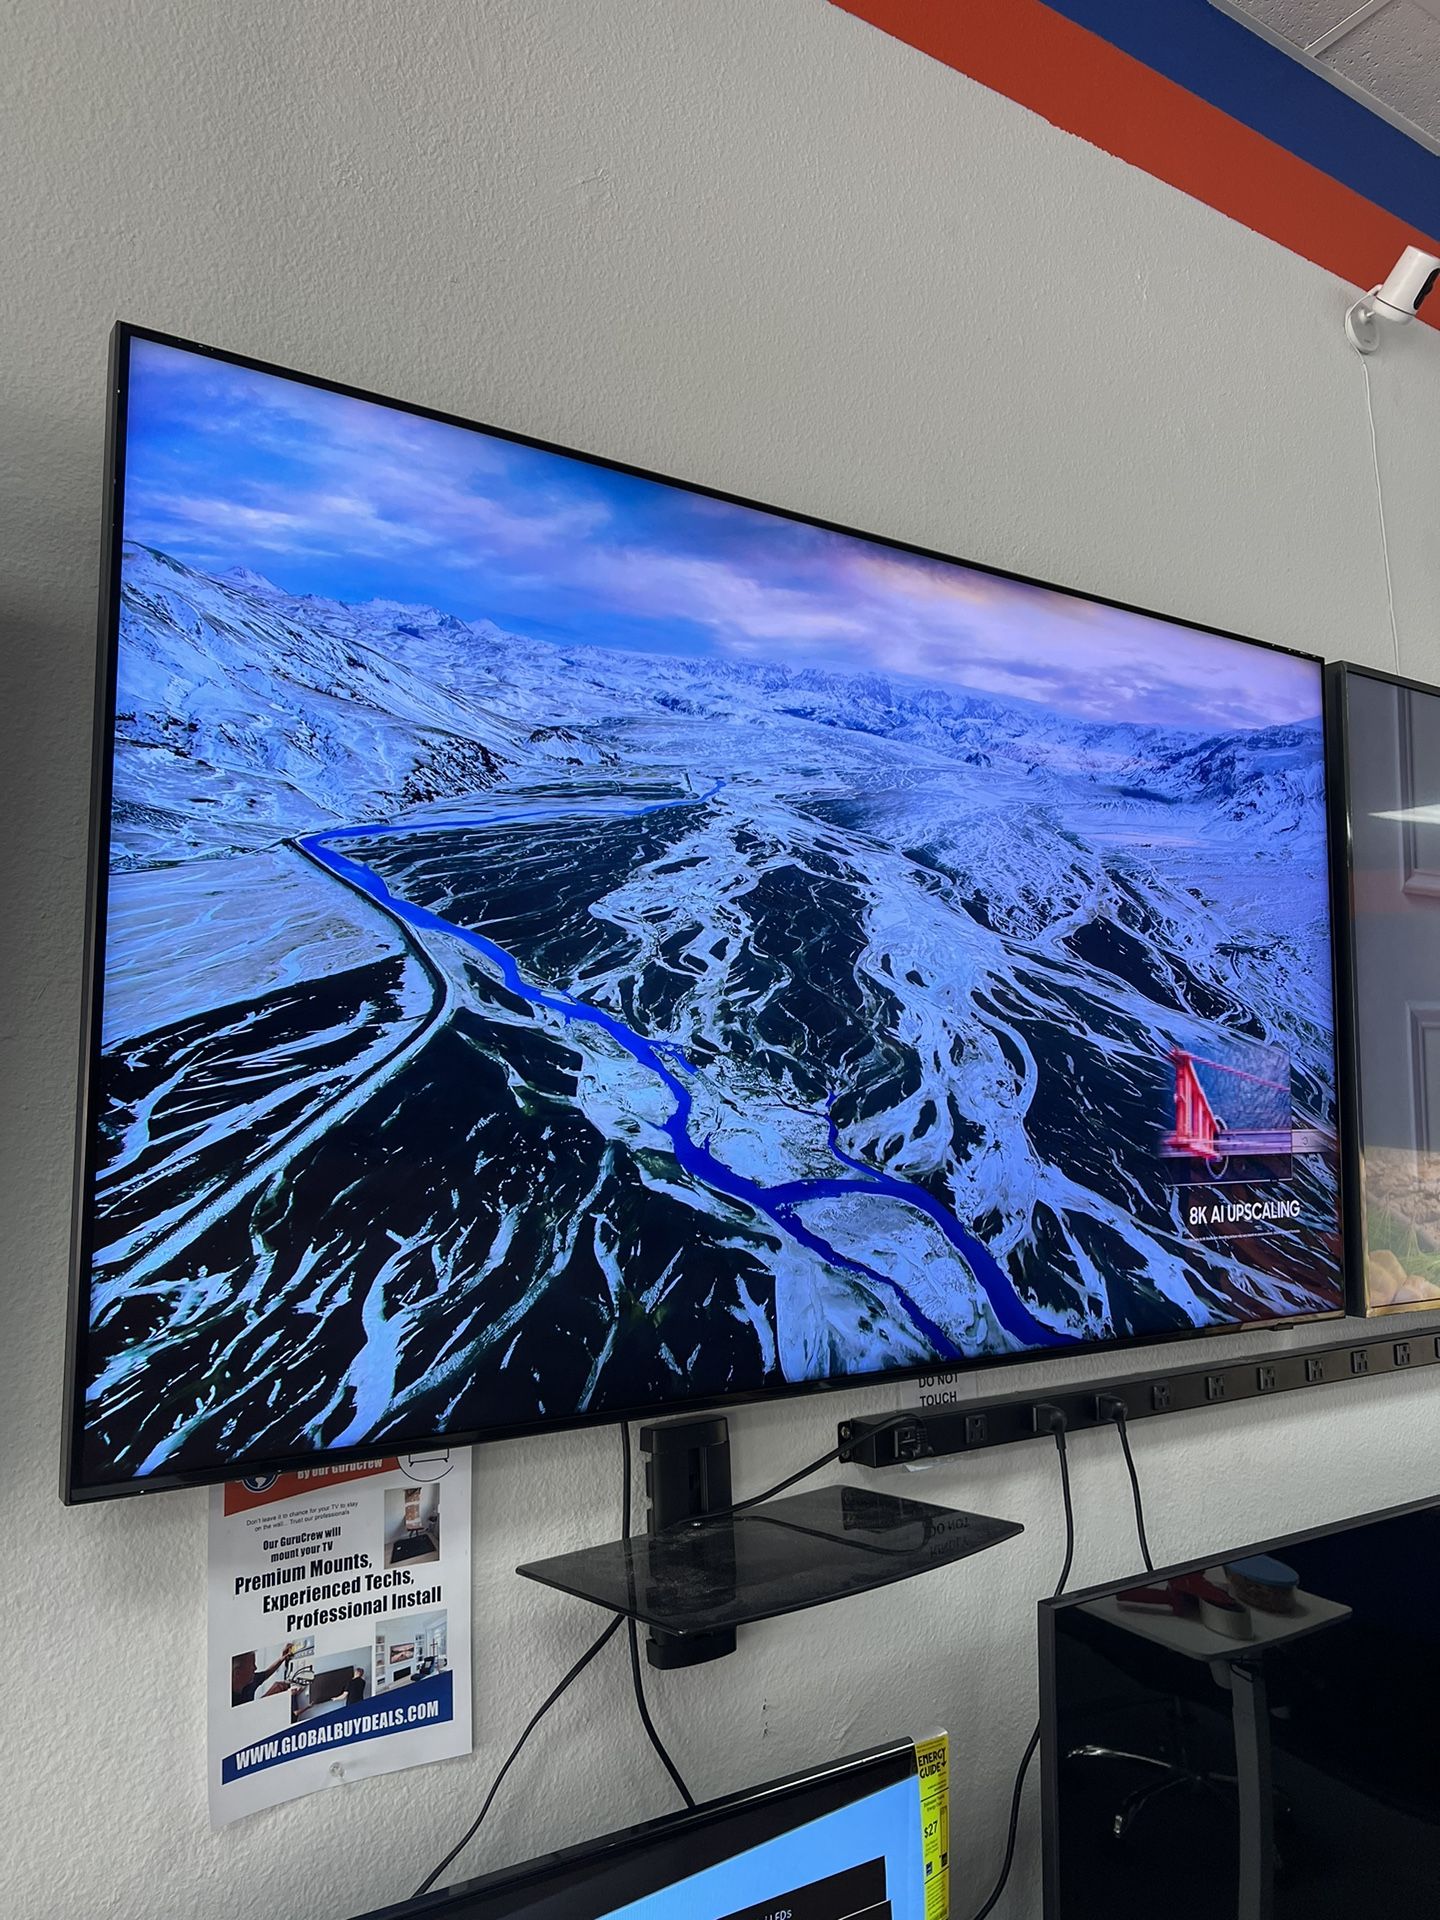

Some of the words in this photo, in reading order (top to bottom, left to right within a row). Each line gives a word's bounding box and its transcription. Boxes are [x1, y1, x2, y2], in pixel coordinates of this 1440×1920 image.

[1189, 1206, 1207, 1225] 8K
[1210, 1205, 1224, 1223] AI
[1227, 1200, 1300, 1222] UPSCALING
[918, 1376, 934, 1388] DO
[938, 1373, 958, 1385] NOT
[920, 1391, 957, 1407] TOUCH
[312, 1466, 329, 1477] our
[262, 1515, 277, 1523] leave
[289, 1510, 308, 1518] chance
[318, 1505, 330, 1513] your
[290, 1517, 303, 1525] Trust
[314, 1509, 350, 1521] professionals
[263, 1539, 279, 1551] Our
[280, 1530, 323, 1547] GuruCrew
[325, 1526, 341, 1538] will
[271, 1547, 299, 1563] mount
[300, 1544, 320, 1560] your
[322, 1540, 333, 1552] TV
[235, 1566, 306, 1595] Premium
[310, 1553, 373, 1578] Mounts,
[263, 1575, 360, 1613] Experienced
[365, 1570, 414, 1592] Techs,
[287, 1596, 387, 1633] Professional
[392, 1586, 441, 1611] Install
[235, 1700, 439, 1770] WWW.GLOBALBUYDEALS.COM
[918, 1747, 946, 1766] ENERGY
[919, 1762, 941, 1779] GUIDE
[924, 1820, 938, 1838] $27
